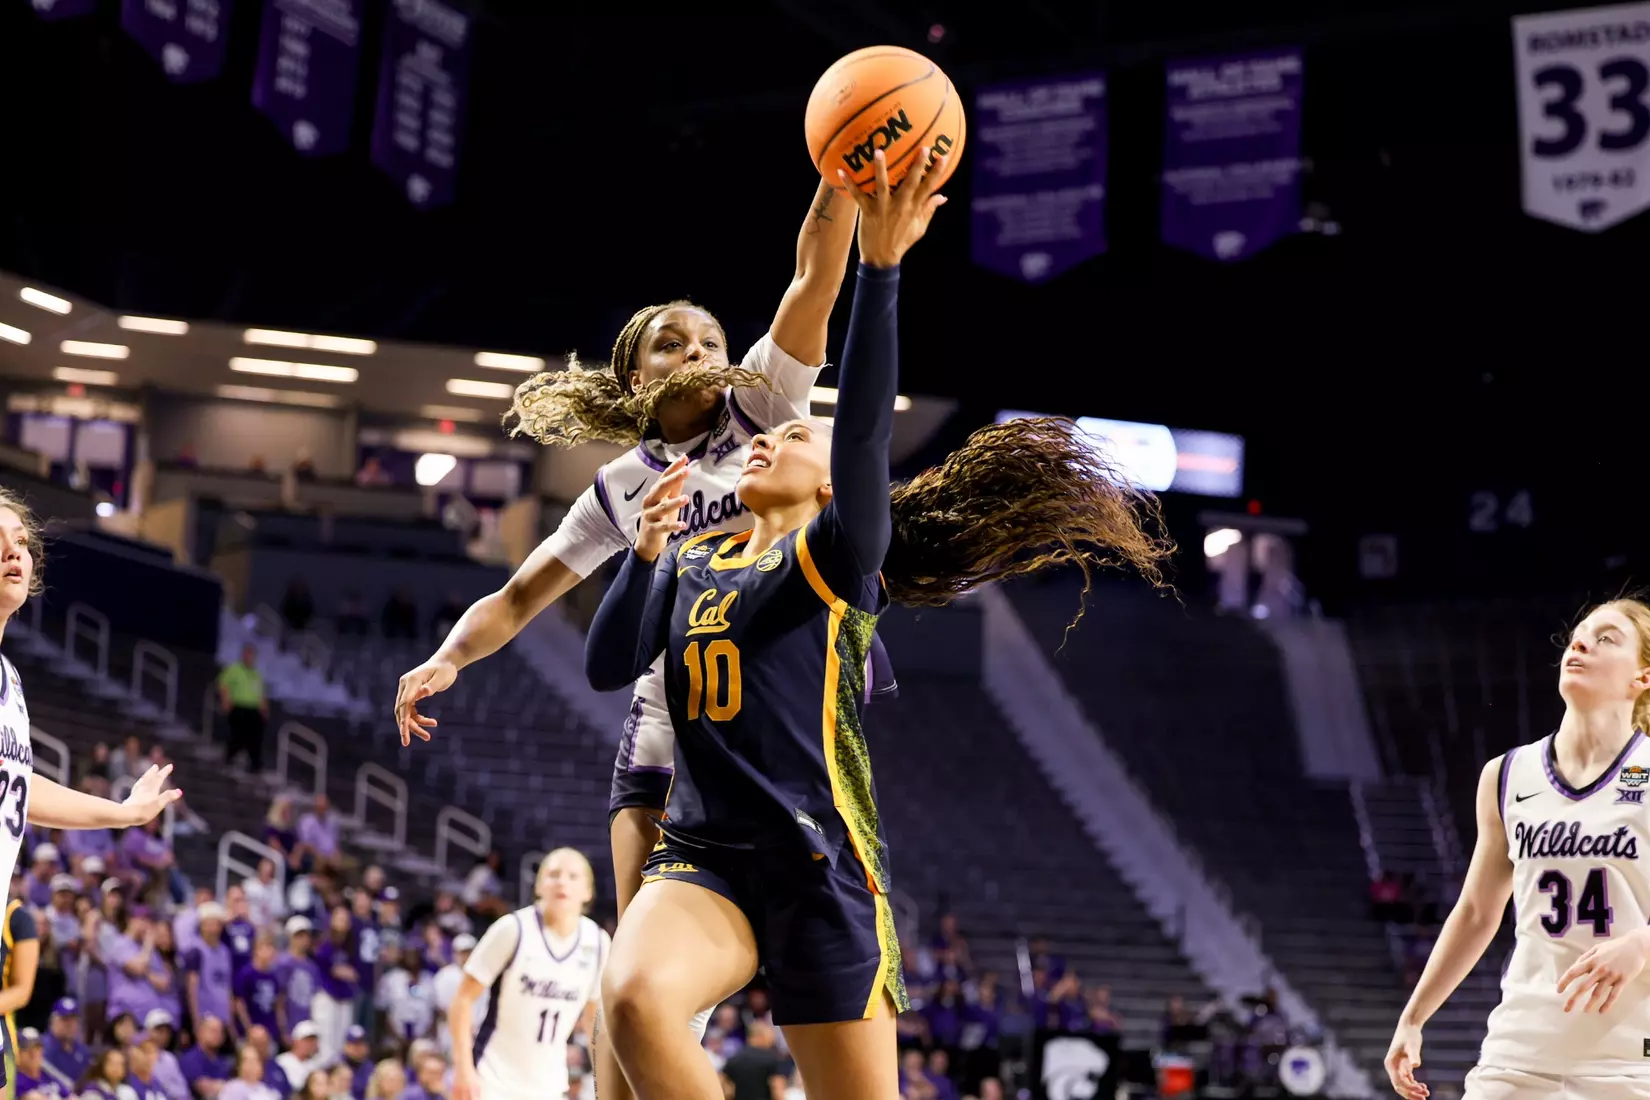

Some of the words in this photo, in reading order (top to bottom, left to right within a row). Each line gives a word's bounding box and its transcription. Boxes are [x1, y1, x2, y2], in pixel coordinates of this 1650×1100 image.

[1532, 57, 1650, 160] 33
[842, 107, 912, 172] NCAA
[685, 588, 738, 637] Cal
[683, 639, 742, 721] 10
[1616, 788, 1645, 803] XII
[1515, 820, 1639, 860] Wildcats
[1538, 867, 1614, 938] 34
[537, 1009, 560, 1043] 11
